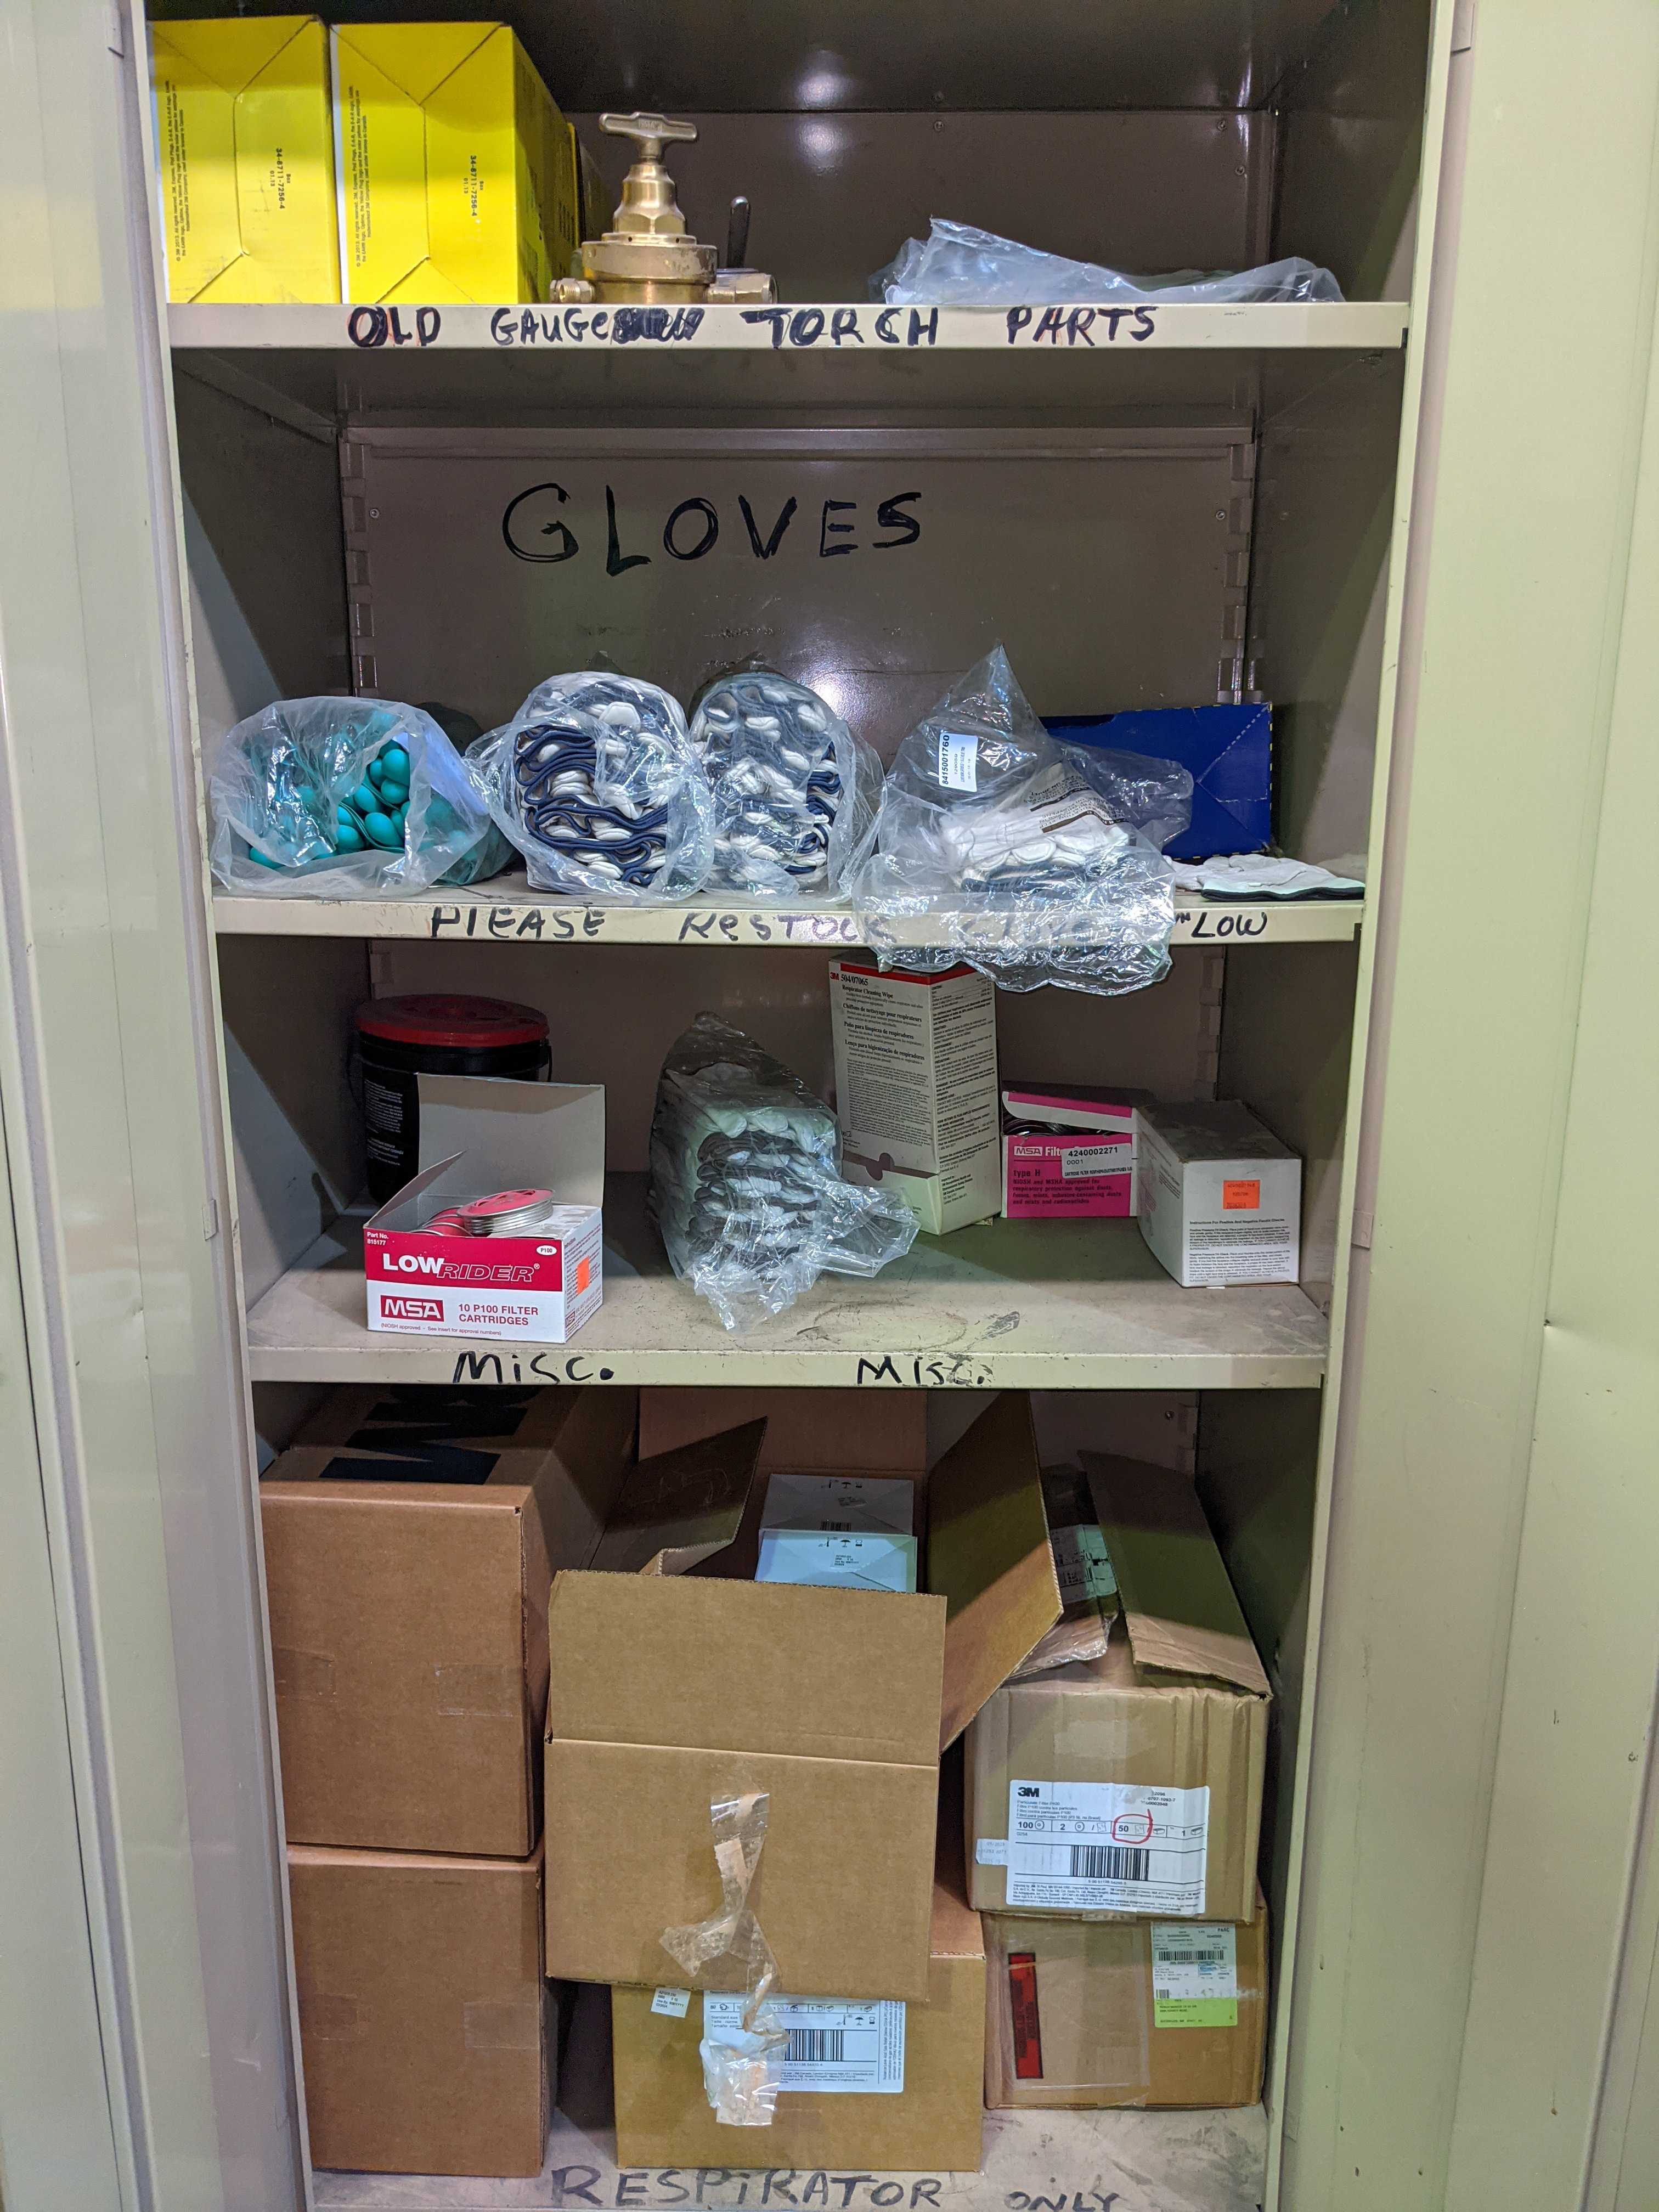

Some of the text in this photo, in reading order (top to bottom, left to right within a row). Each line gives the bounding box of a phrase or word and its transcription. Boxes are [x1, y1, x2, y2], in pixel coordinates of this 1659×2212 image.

[276, 148, 285, 209] 34-8711-7256-4
[347, 306, 441, 347] OLD
[739, 307, 938, 349] TORCH
[1006, 306, 1159, 347] PARTS
[502, 483, 921, 577] GLOVES
[941, 735, 950, 785] 8415001760
[830, 972, 839, 981] 3M
[842, 985, 862, 993] Respirator
[1045, 1146, 1062, 1157] Filt
[1068, 1147, 1119, 1157] 4240002271
[1014, 1169, 1041, 1178] type H
[385, 1298, 442, 1319] MSA
[458, 1303, 539, 1316] 10 P100 FILTER
[459, 1314, 530, 1326] CARTRIDGES
[1017, 1787, 1040, 1798] 3M
[1018, 1821, 1034, 1829] 100
[1005, 2191, 1121, 2212] ONLY
